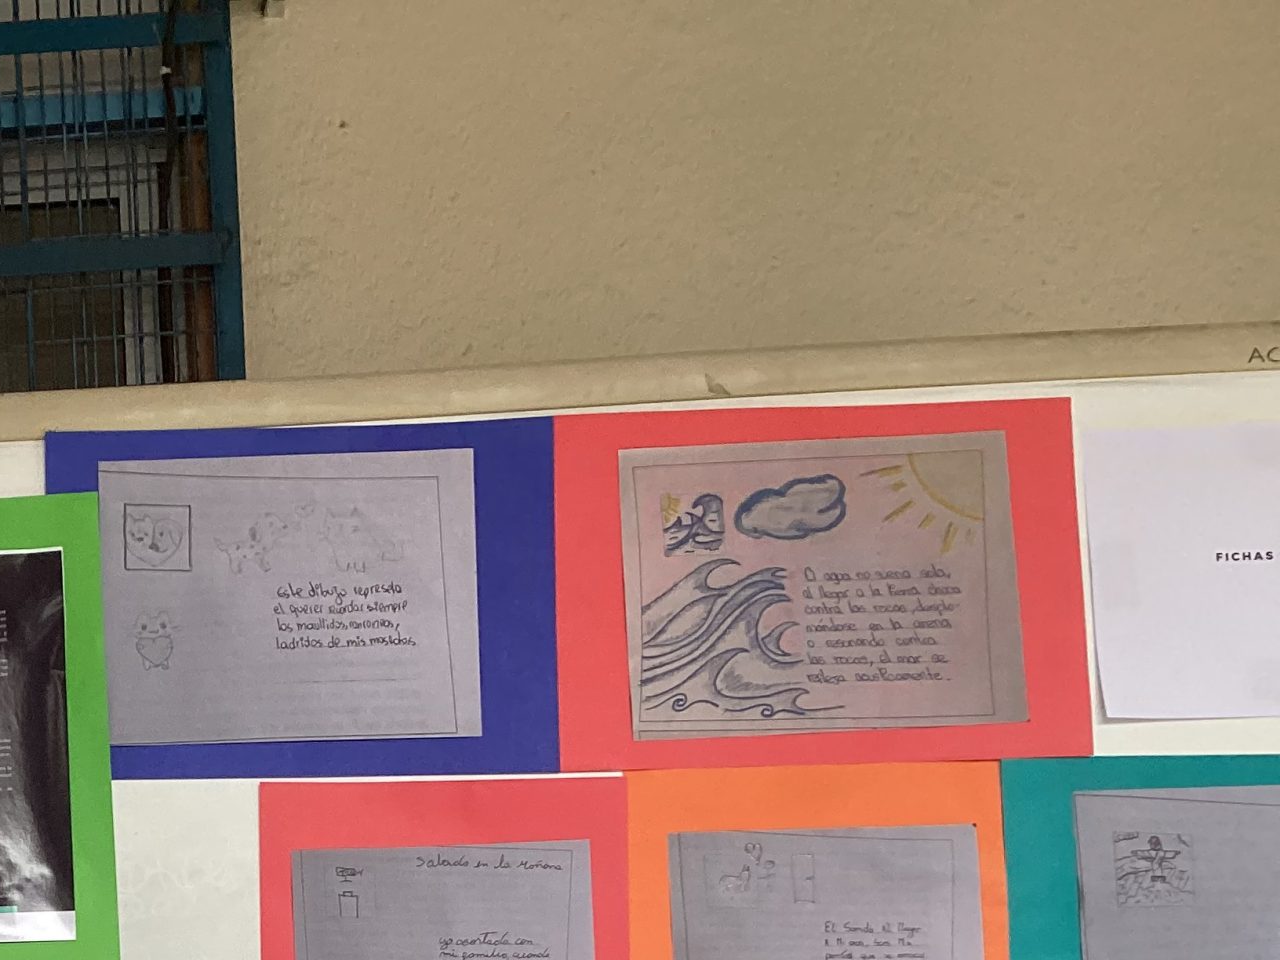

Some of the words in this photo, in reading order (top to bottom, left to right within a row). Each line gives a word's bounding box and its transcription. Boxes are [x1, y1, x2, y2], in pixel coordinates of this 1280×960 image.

[1215, 551, 1274, 562] FICHAS
[276, 582, 303, 599] Este
[307, 581, 347, 606] dibujo
[856, 588, 865, 598] a
[869, 583, 883, 597] la
[273, 602, 285, 615] el
[366, 600, 408, 613] siempre
[804, 601, 844, 615] contra
[276, 618, 293, 632] los
[869, 622, 884, 631] en
[889, 617, 903, 631] la
[276, 635, 322, 650] ladridos
[327, 636, 341, 648] de
[346, 636, 366, 647] mis
[807, 651, 826, 665] las
